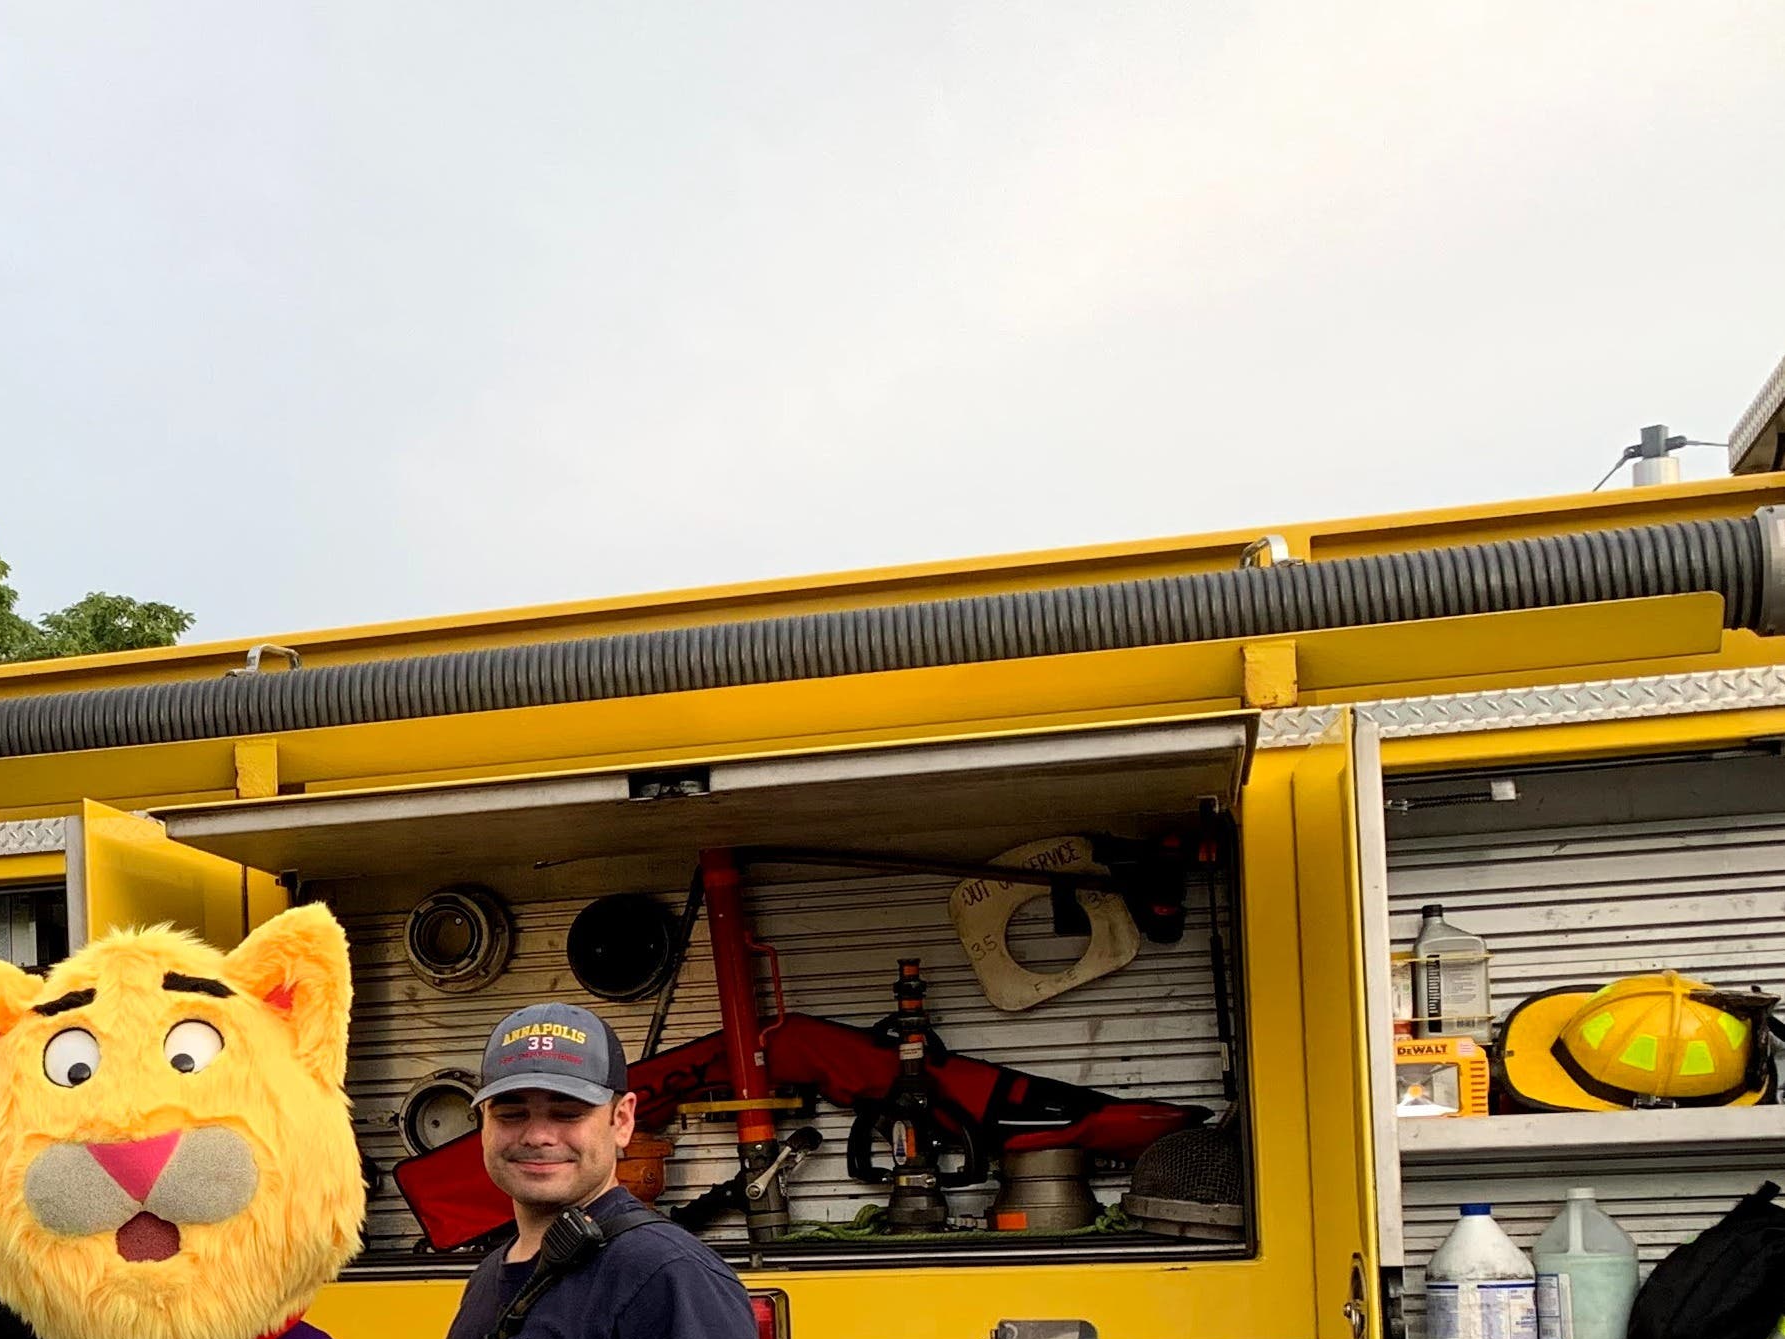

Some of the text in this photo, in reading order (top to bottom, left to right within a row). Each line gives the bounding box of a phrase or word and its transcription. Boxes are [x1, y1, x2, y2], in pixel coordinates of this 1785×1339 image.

[971, 934, 998, 961] 35
[501, 1023, 587, 1047] ANNAPOLIS
[528, 1036, 554, 1050] 35
